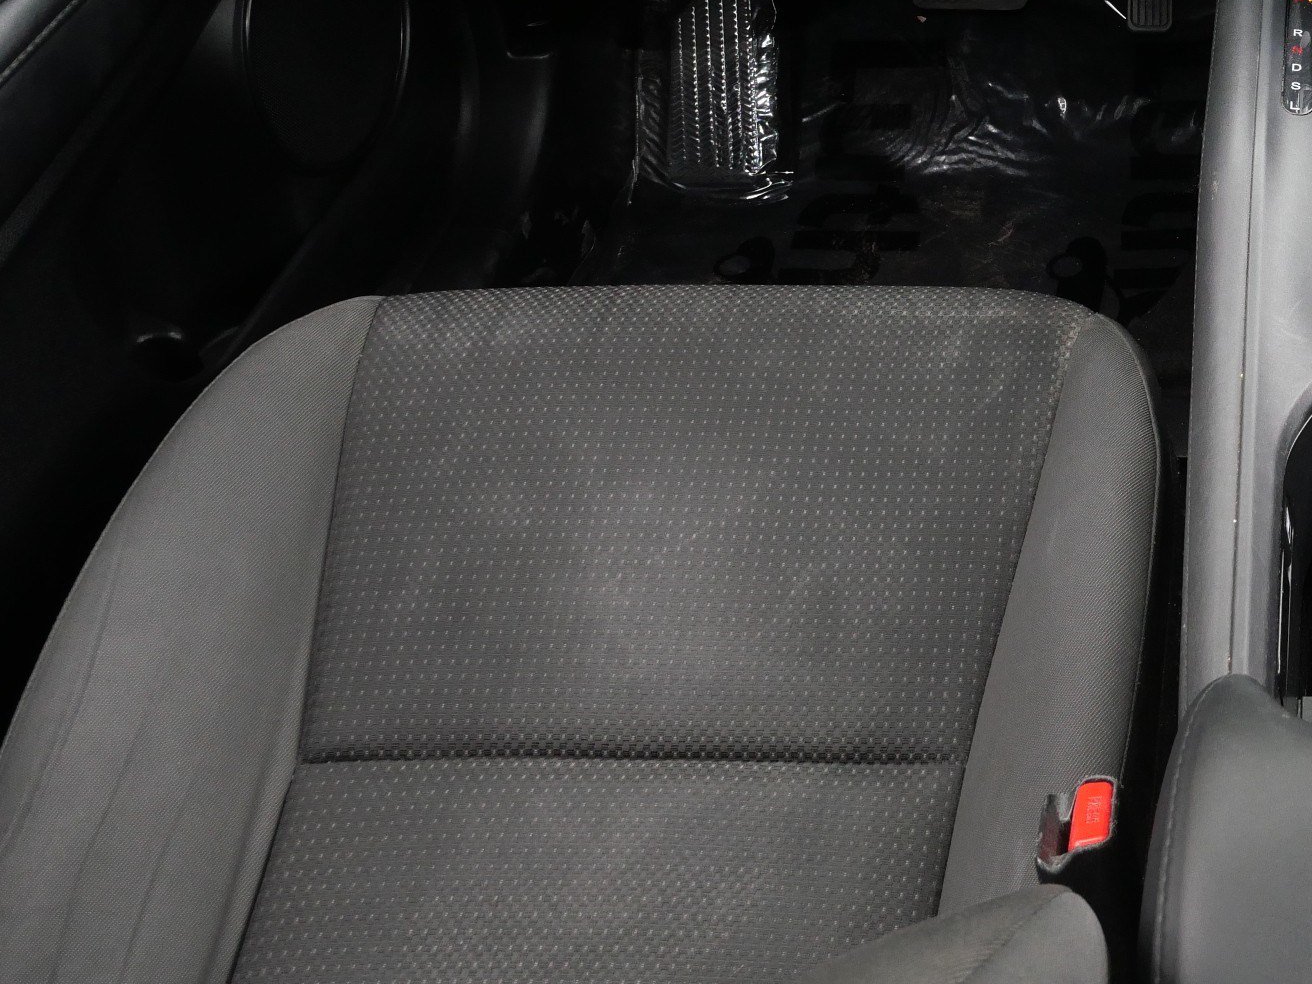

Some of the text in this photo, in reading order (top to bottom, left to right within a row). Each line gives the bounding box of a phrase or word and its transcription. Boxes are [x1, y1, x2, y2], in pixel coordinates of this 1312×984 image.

[1293, 29, 1303, 37] R
[1292, 64, 1302, 72] D
[1291, 82, 1301, 90] S
[1290, 102, 1300, 110] L
